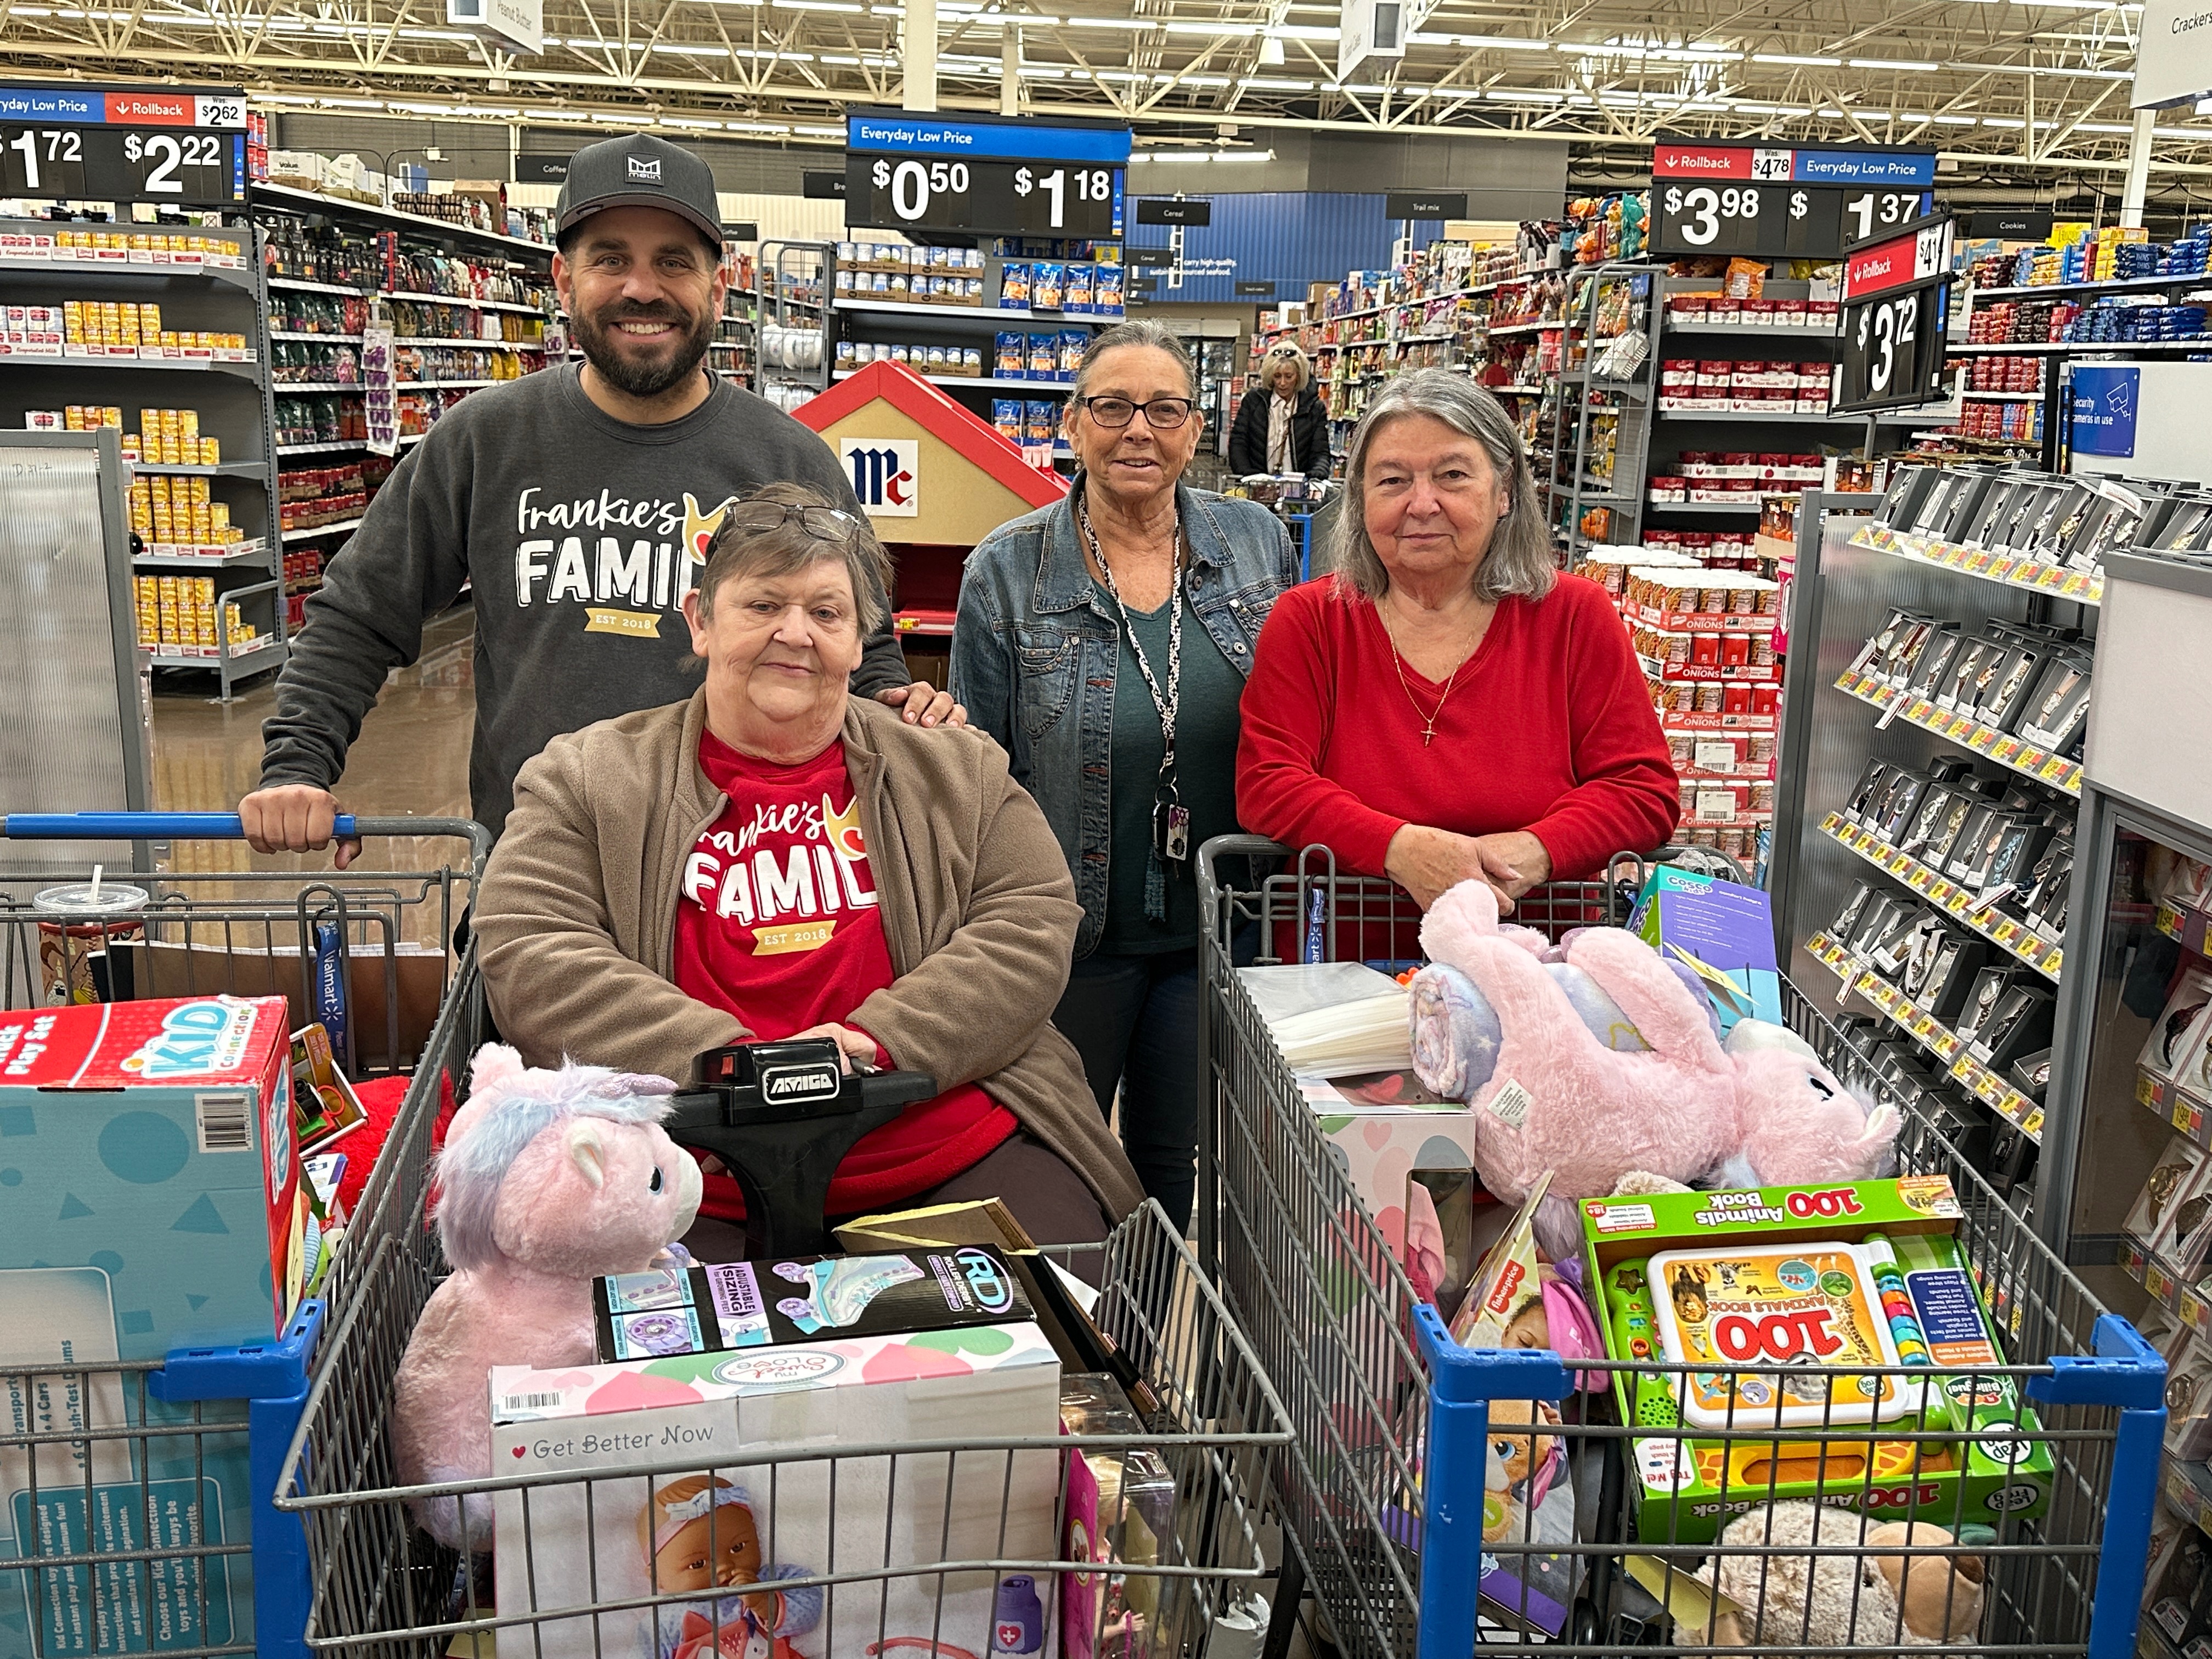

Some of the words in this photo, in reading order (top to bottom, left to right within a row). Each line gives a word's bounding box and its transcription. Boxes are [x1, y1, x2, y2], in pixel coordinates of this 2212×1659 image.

[0, 98, 30, 113] yday
[32, 99, 55, 111] Low
[59, 100, 87, 112] Price
[132, 103, 183, 116] Rollback
[861, 126, 915, 143] Everyday
[917, 128, 941, 143] Low
[943, 131, 972, 145] Price
[0, 130, 82, 188] 172
[543, 165, 566, 173] Coffee
[1680, 156, 1731, 169] Rollback
[1807, 160, 1859, 176] Everyday
[1861, 162, 1885, 174] Low
[1888, 163, 1917, 176] Price
[629, 172, 661, 180] melin
[1863, 256, 1892, 280] Rollback
[2094, 413, 2100, 424] in
[2102, 415, 2113, 425] use
[518, 488, 685, 535] Frankie's
[595, 614, 617, 625] EST
[622, 618, 651, 630] 2018
[1686, 620, 1723, 629] ONIONS
[1683, 669, 1719, 678] ONIONS
[697, 802, 826, 856] rankie's
[682, 845, 878, 927] FAMIL
[764, 934, 787, 945] EST
[794, 928, 827, 941] 2018
[324, 950, 337, 1005] Walmart
[150, 1001, 227, 1073] KID
[770, 1074, 834, 1094] AMIGO
[1707, 1191, 1761, 1209] Book
[1786, 1188, 1863, 1217] 100
[1694, 1206, 1784, 1226] Animals
[957, 1255, 1006, 1305] RD
[723, 1270, 742, 1311] SIZING
[956, 1281, 974, 1307] DERBY
[1707, 1301, 1752, 1313] BOOK
[1753, 1295, 1825, 1312] ANIMALS
[1716, 1309, 1843, 1361] 100
[61, 1340, 76, 1380] Dums
[727, 1357, 826, 1379] Sweet
[37, 1383, 50, 1410] Cars
[65, 1384, 84, 1448] Cash-Test
[533, 1439, 574, 1459] Get
[582, 1432, 654, 1453] Better
[661, 1425, 714, 1445] Now
[1857, 1482, 1940, 1508] 100
[55, 1502, 65, 1520] fun!
[99, 1492, 113, 1541] excitement
[166, 1500, 177, 1514] be
[37, 1505, 52, 1545] designed
[149, 1495, 162, 1550] onnection
[48, 1565, 58, 1582] toy
[64, 1566, 75, 1582] and
[125, 1562, 135, 1577] the
[151, 1561, 165, 1579] Kid
[67, 1584, 79, 1602] play
[109, 1582, 119, 1600] that
[127, 1578, 139, 1618] stimulate
[156, 1581, 166, 1600] our
[174, 1588, 187, 1607] and
[50, 1584, 64, 1633] Connection
[69, 1605, 81, 1634] instant
[97, 1610, 109, 1648] Everyday
[132, 1620, 142, 1635] and
[159, 1602, 172, 1640] Choose
[178, 1610, 191, 1633] toys
[56, 1635, 66, 1649] Kid
[74, 1636, 83, 1649] for
